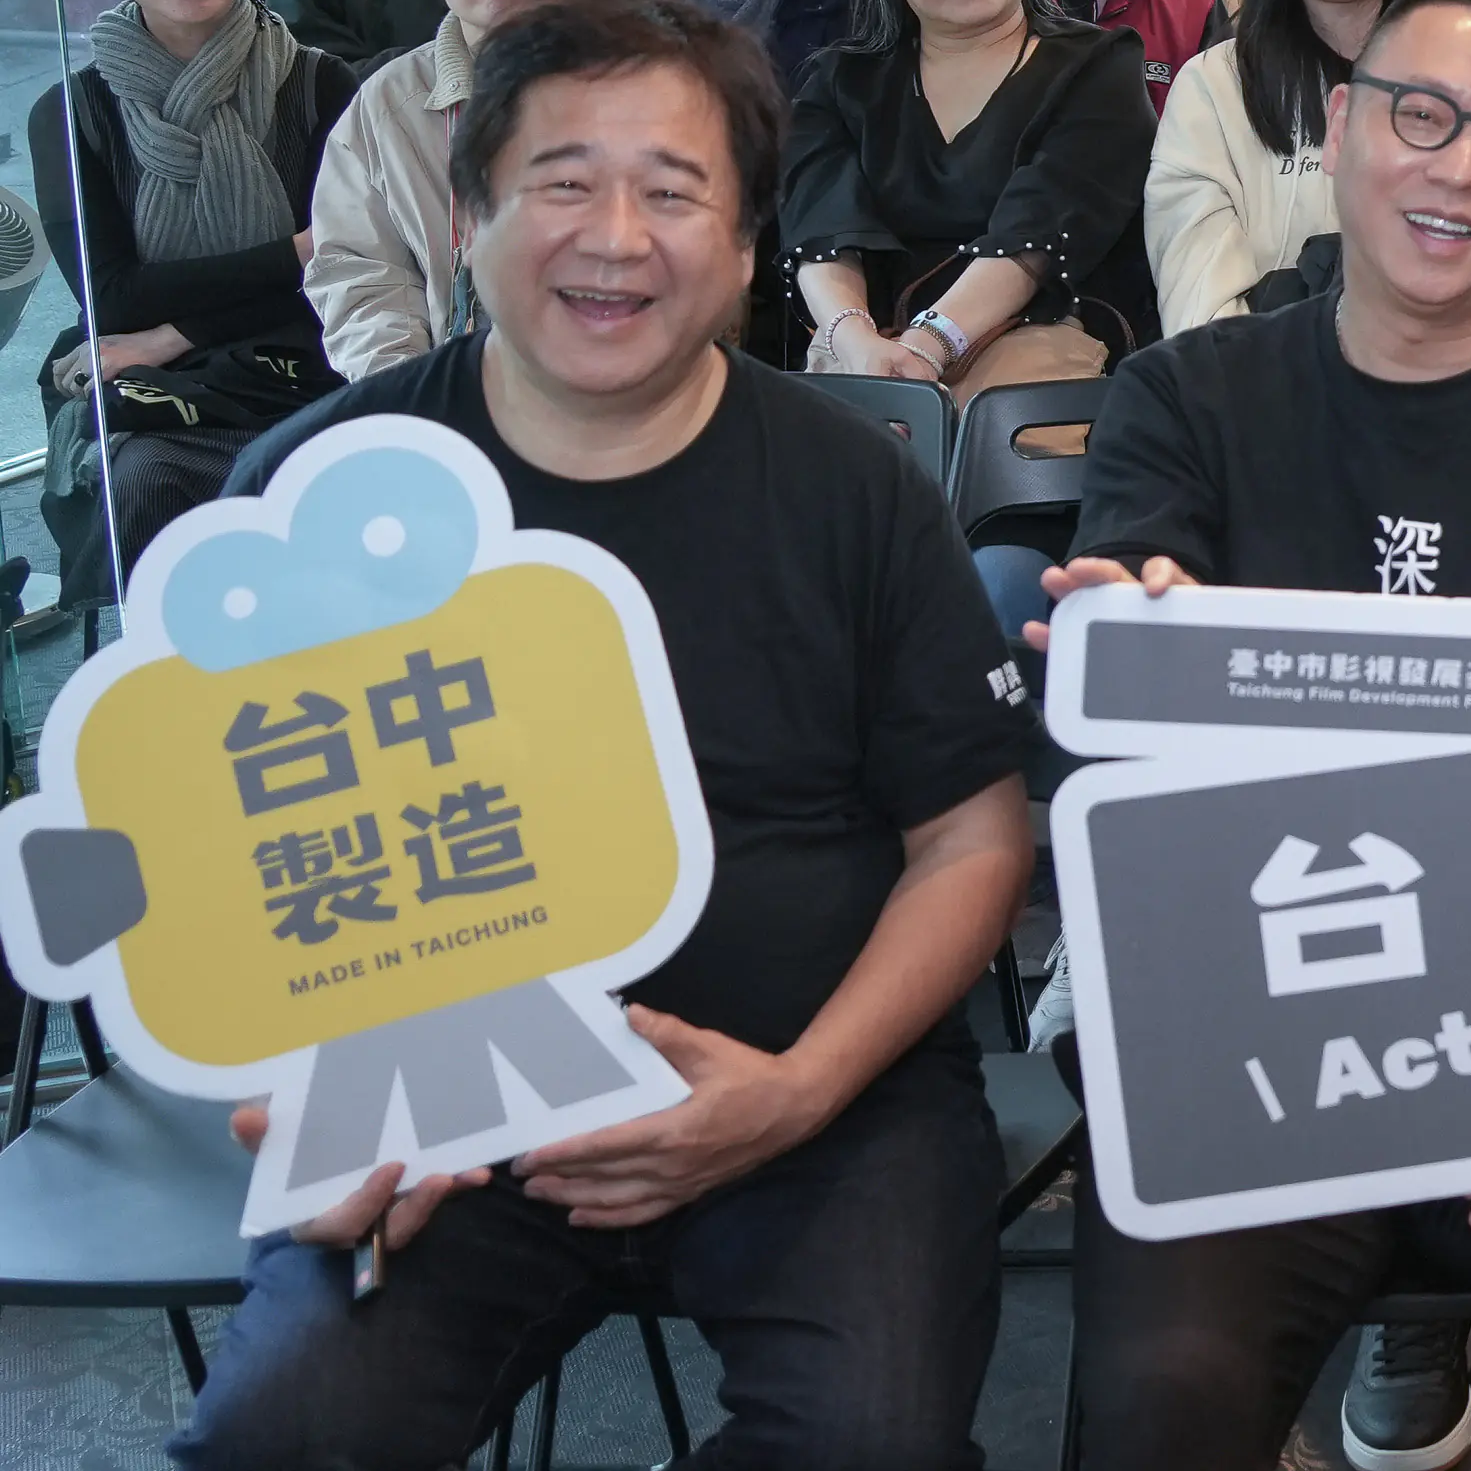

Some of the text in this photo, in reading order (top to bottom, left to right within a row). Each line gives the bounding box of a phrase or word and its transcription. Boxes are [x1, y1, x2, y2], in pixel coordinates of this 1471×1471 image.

[1373, 515, 1443, 595] 深
[222, 648, 497, 816] 台中
[1227, 681, 1305, 703] Taichung
[1308, 685, 1345, 703] Film
[1349, 687, 1460, 709] Development
[251, 780, 537, 946] 製造
[288, 905, 549, 997] MADE IN TAICHUNG
